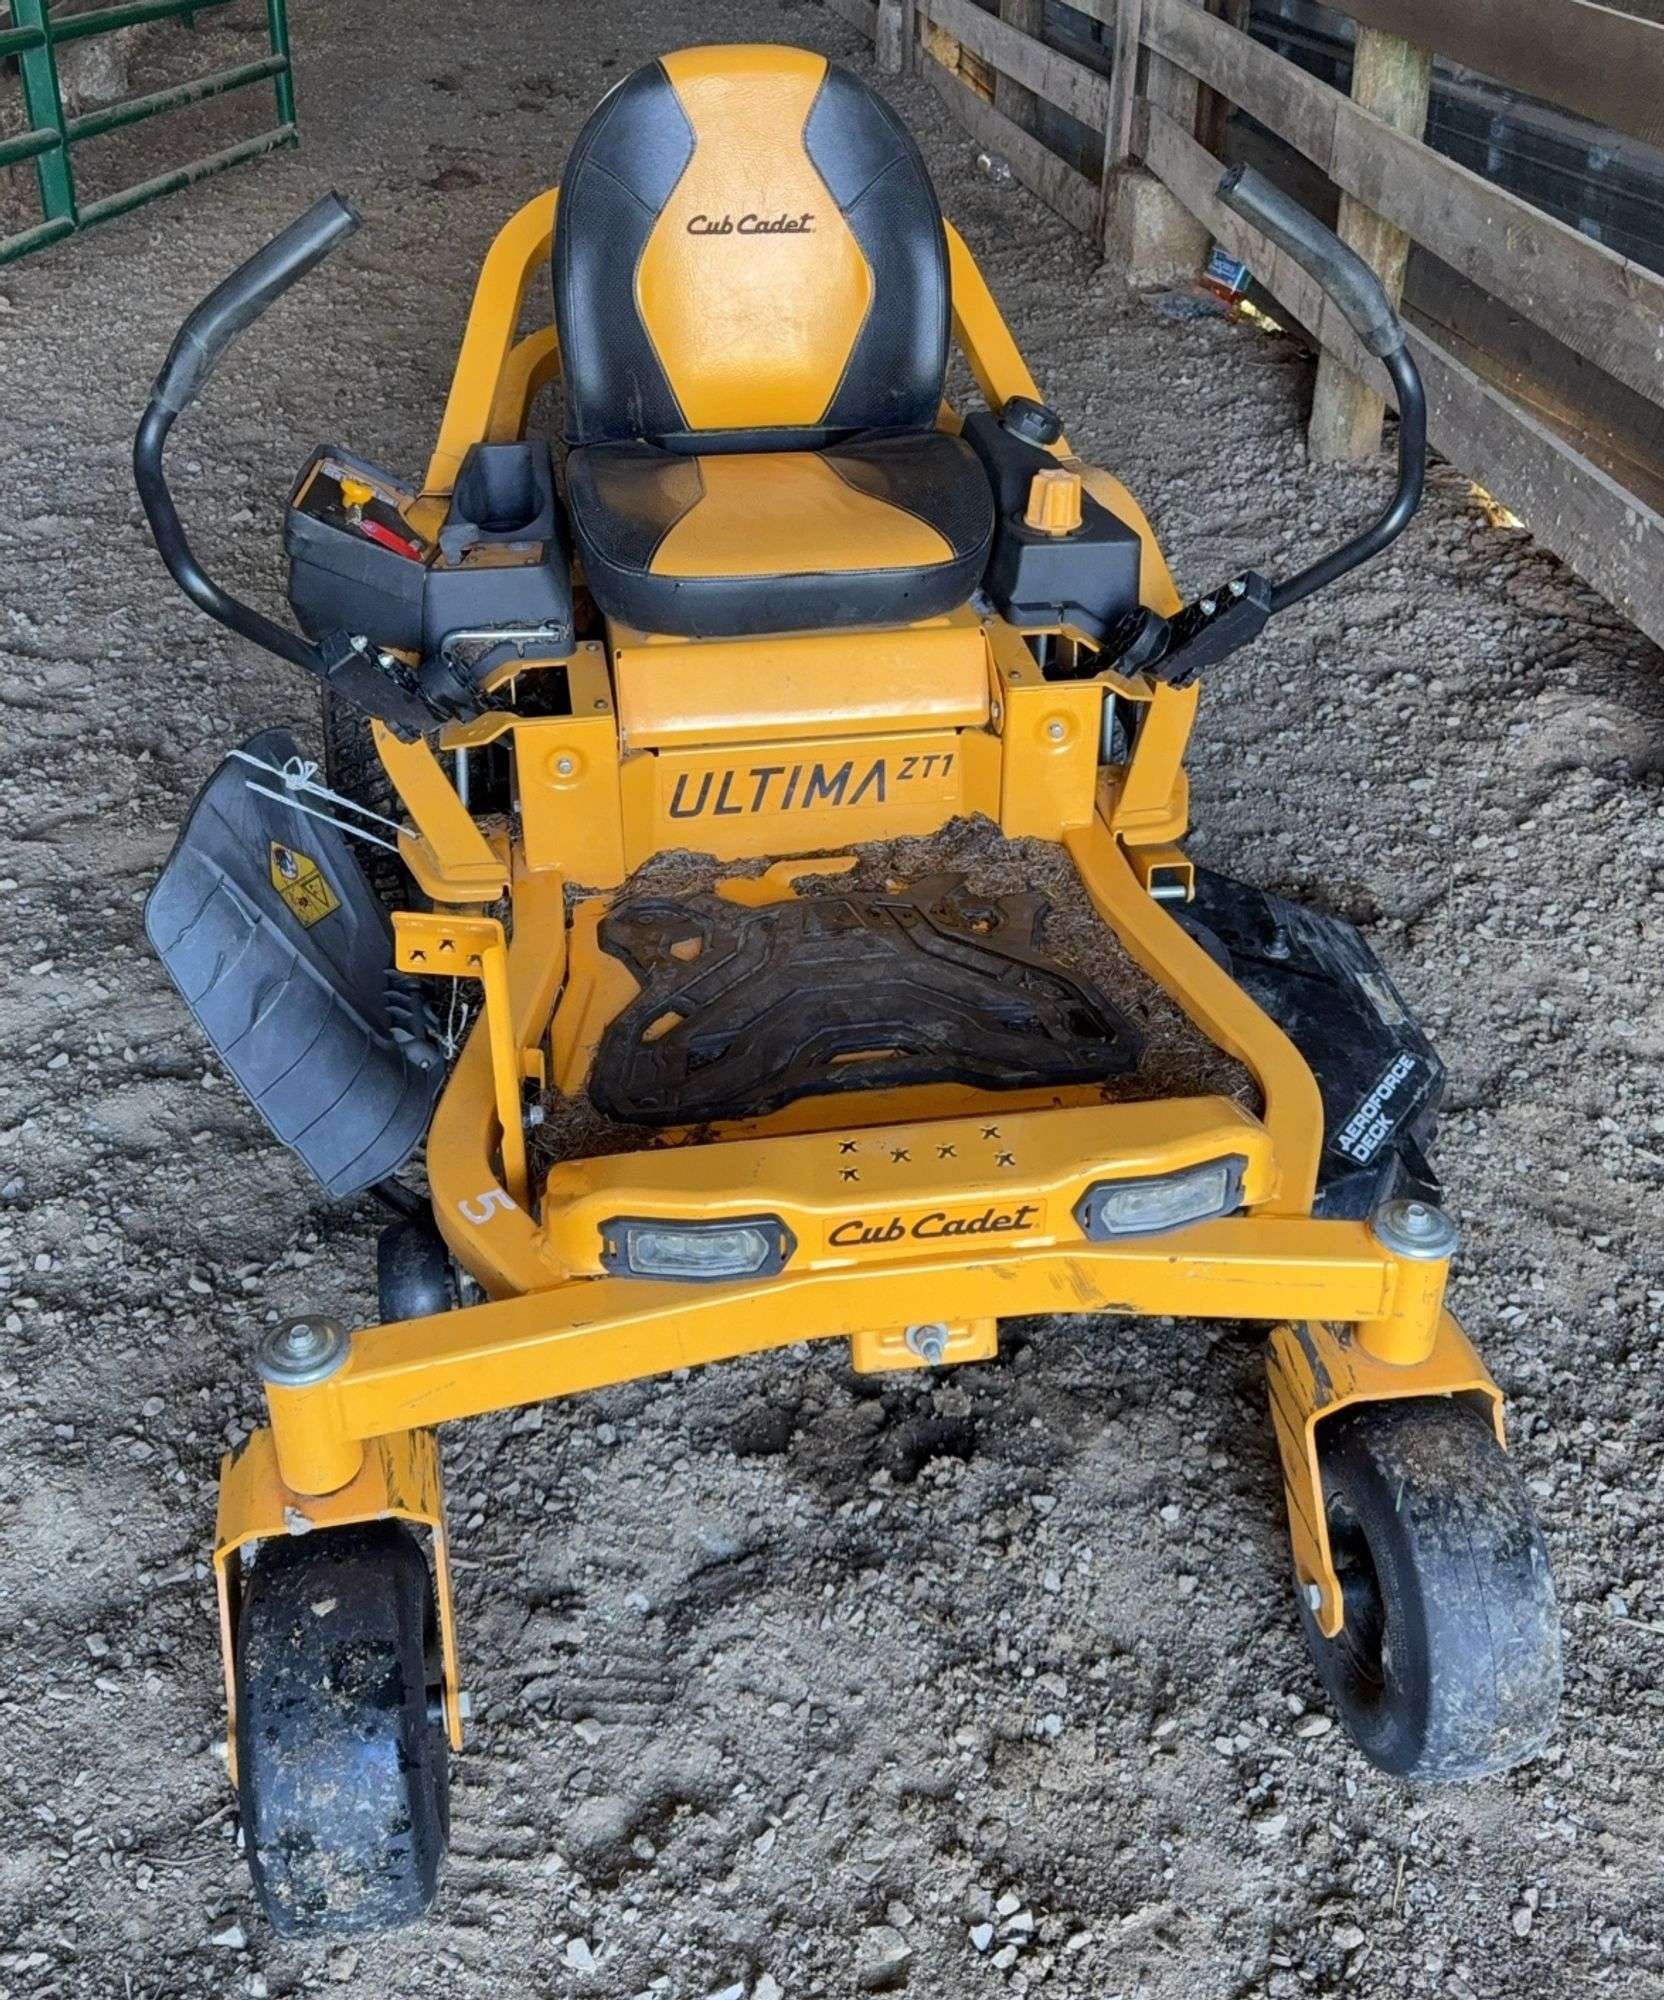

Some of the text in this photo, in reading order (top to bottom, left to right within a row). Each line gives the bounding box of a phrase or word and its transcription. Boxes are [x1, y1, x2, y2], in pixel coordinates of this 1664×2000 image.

[687, 213, 815, 234] Cub Cadet
[670, 754, 954, 819] ULTIMA ZT1
[1338, 1054, 1416, 1152] AEROFORCE
[1351, 1113, 1395, 1163] DECK
[458, 1188, 517, 1225] 5
[828, 1205, 1039, 1247] Cub Cadet
